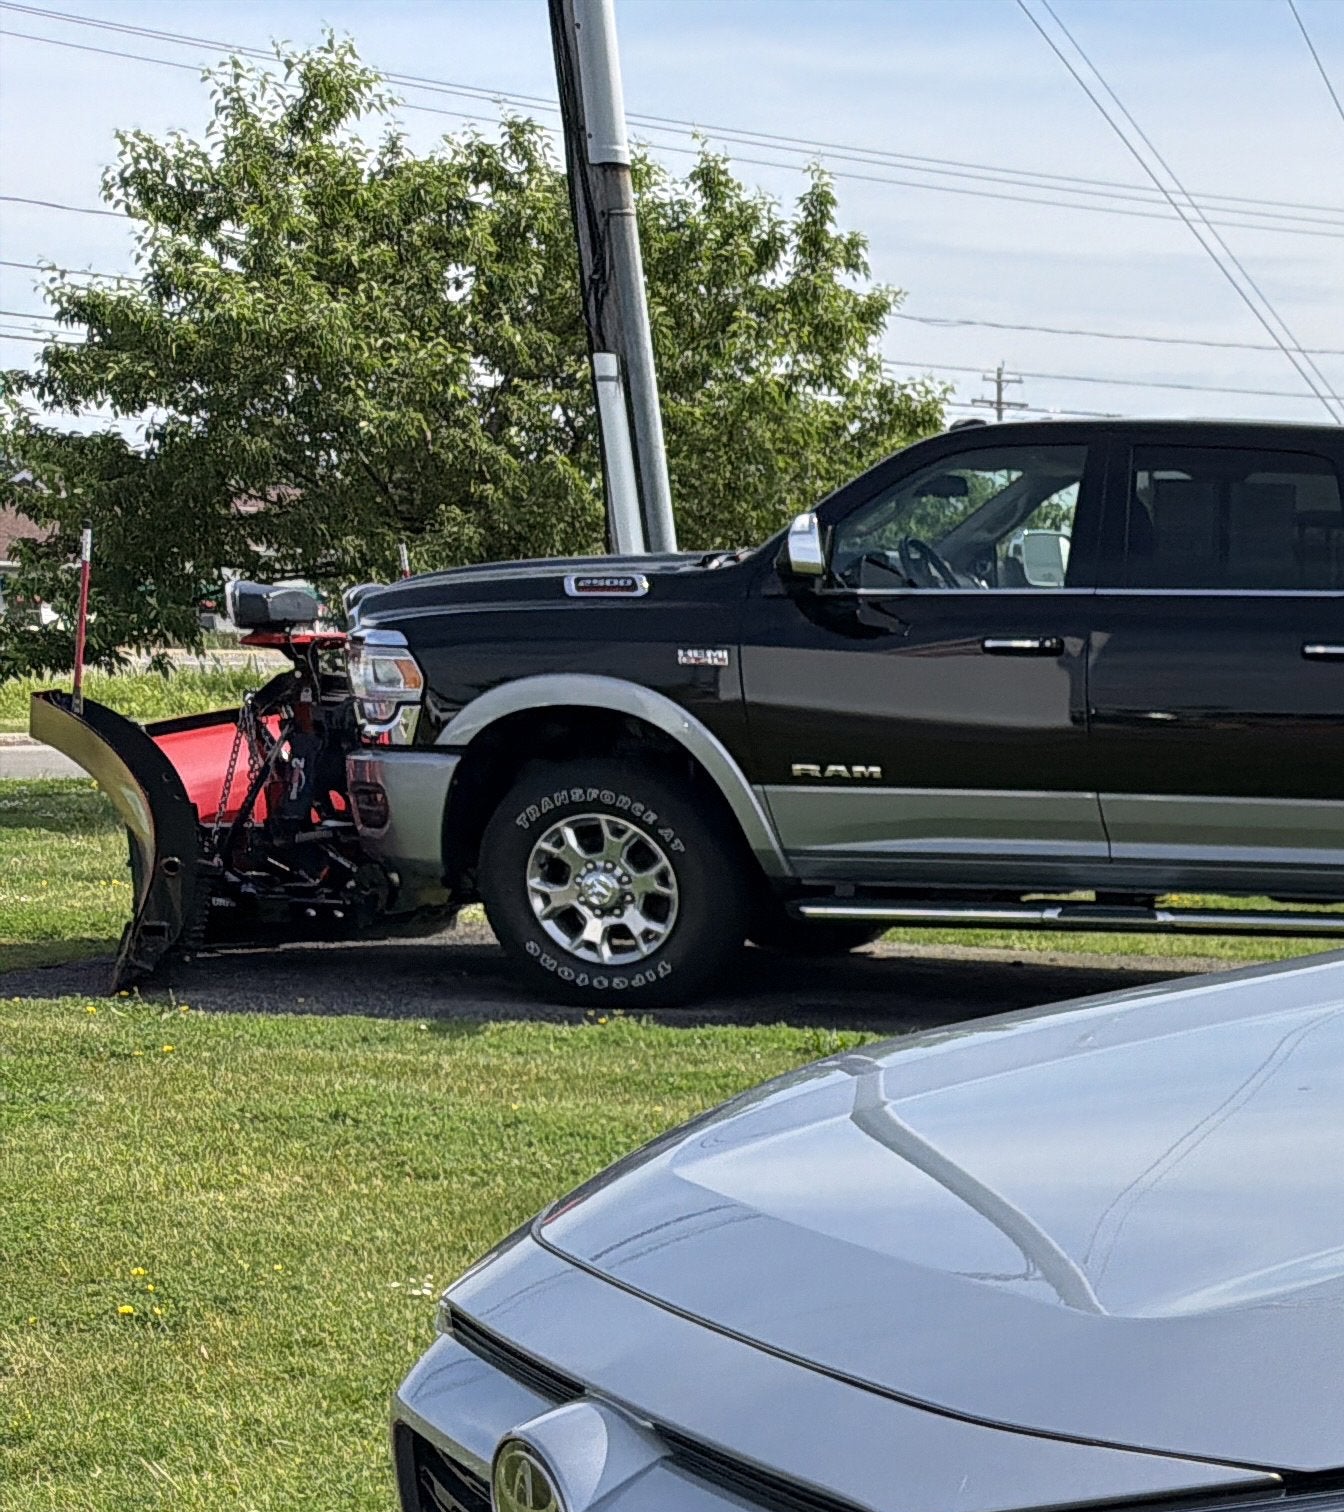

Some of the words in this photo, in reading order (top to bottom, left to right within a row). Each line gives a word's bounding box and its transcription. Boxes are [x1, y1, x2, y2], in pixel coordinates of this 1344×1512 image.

[577, 579, 633, 587] 2500
[677, 648, 729, 658] HEMI
[791, 763, 882, 779] RAM
[657, 826, 687, 853] AT
